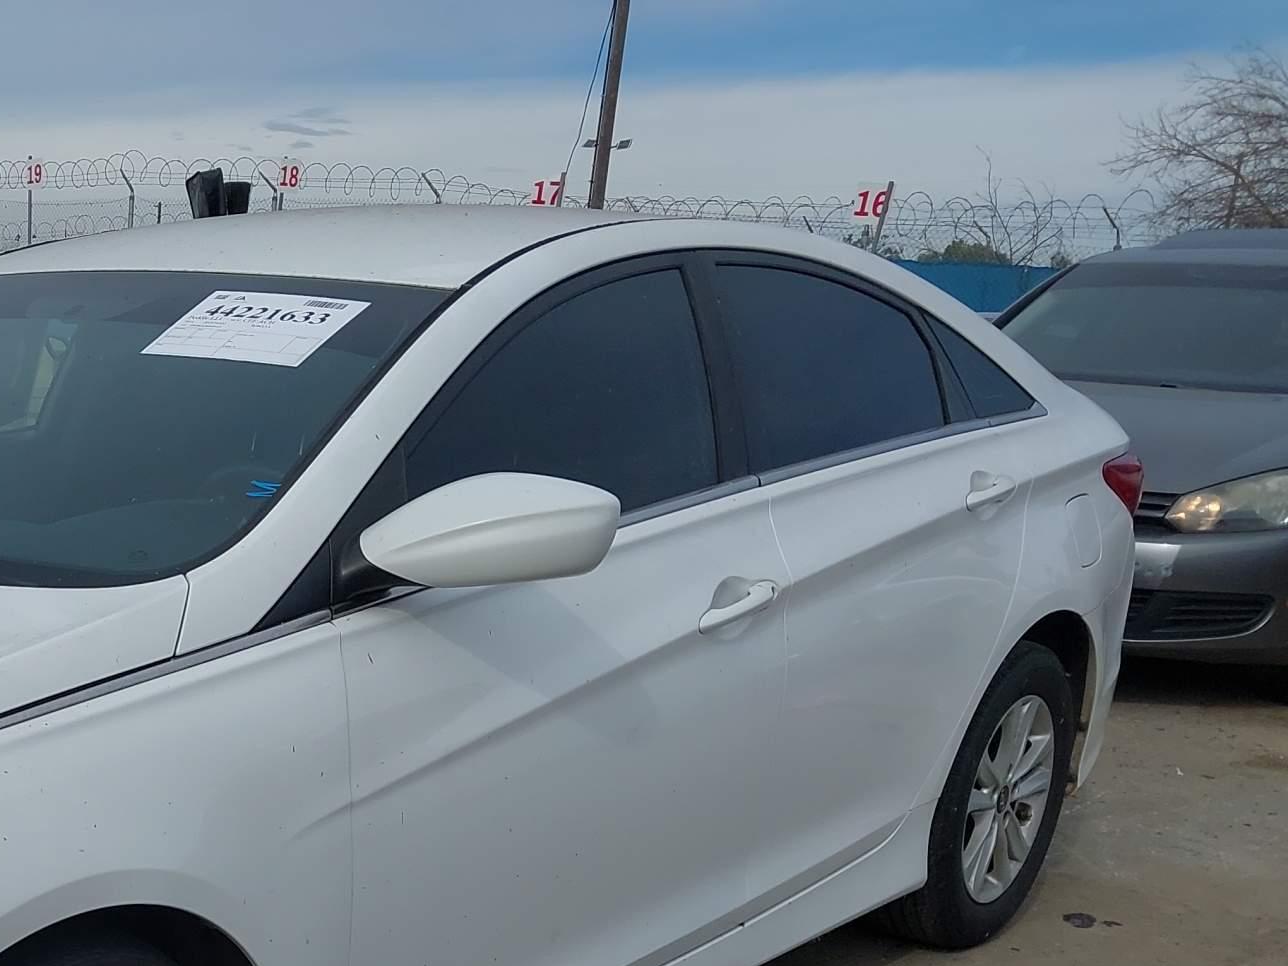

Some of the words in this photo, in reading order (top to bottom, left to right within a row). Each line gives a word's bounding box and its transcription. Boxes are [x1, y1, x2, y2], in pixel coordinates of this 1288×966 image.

[27, 164, 42, 183] 19
[279, 165, 300, 188] 18
[531, 180, 561, 206] 17
[853, 190, 888, 217] 16
[206, 304, 331, 325] 44221633
